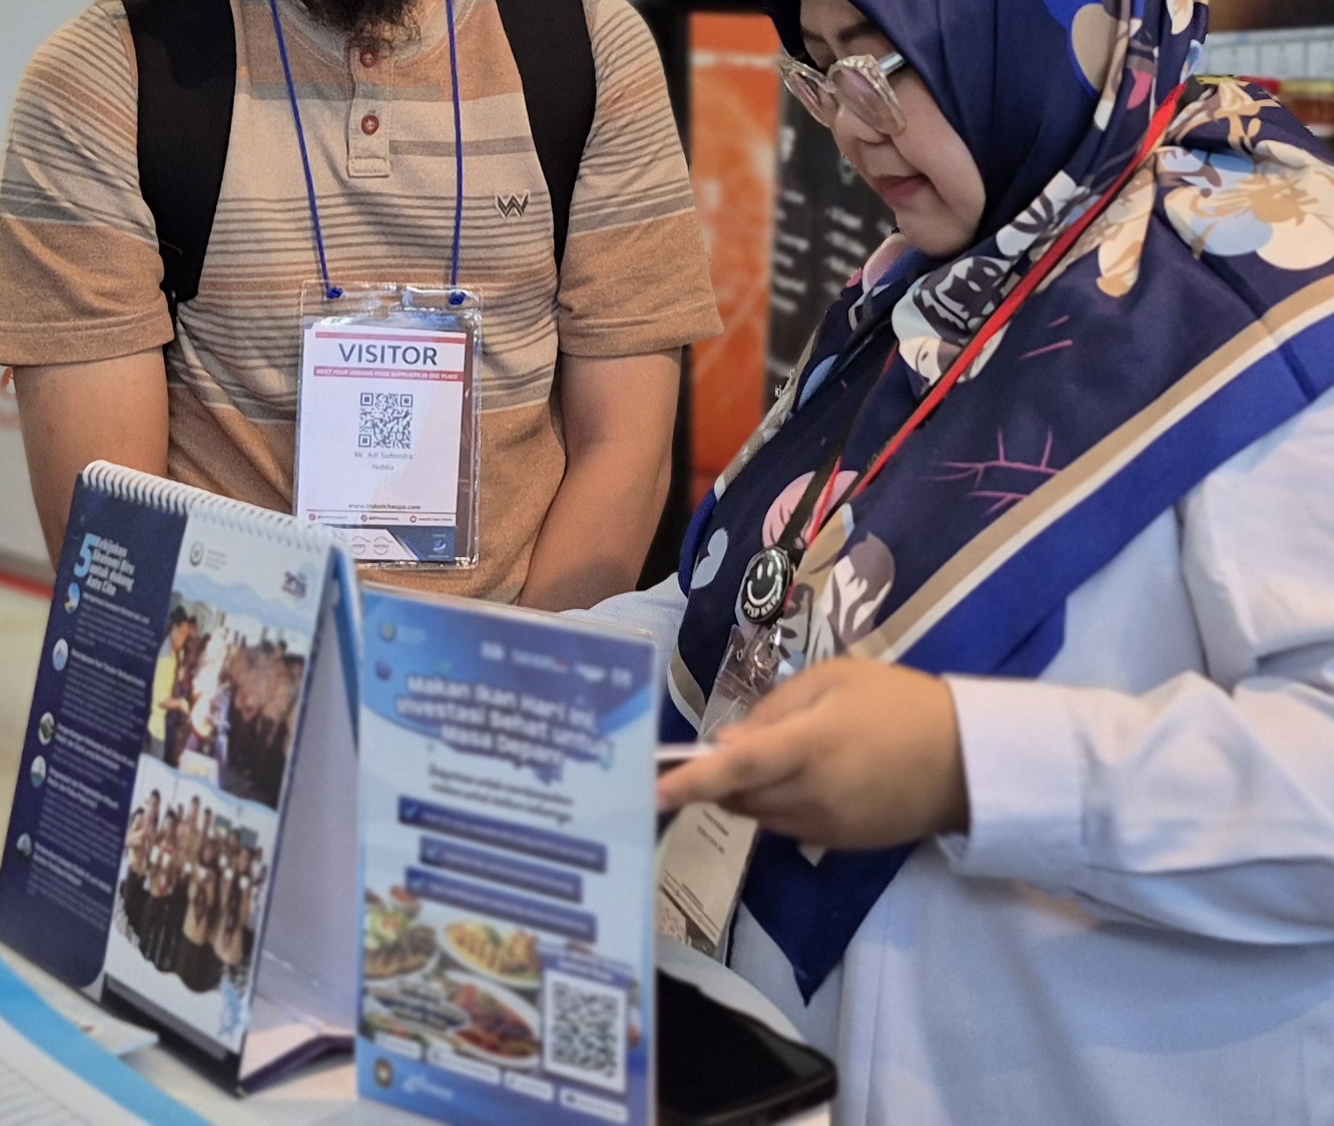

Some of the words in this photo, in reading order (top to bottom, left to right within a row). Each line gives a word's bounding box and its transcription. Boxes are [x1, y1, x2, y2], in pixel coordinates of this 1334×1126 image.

[338, 343, 438, 366] VISITOR
[440, 372, 458, 380] PLACE
[73, 532, 99, 578] 5
